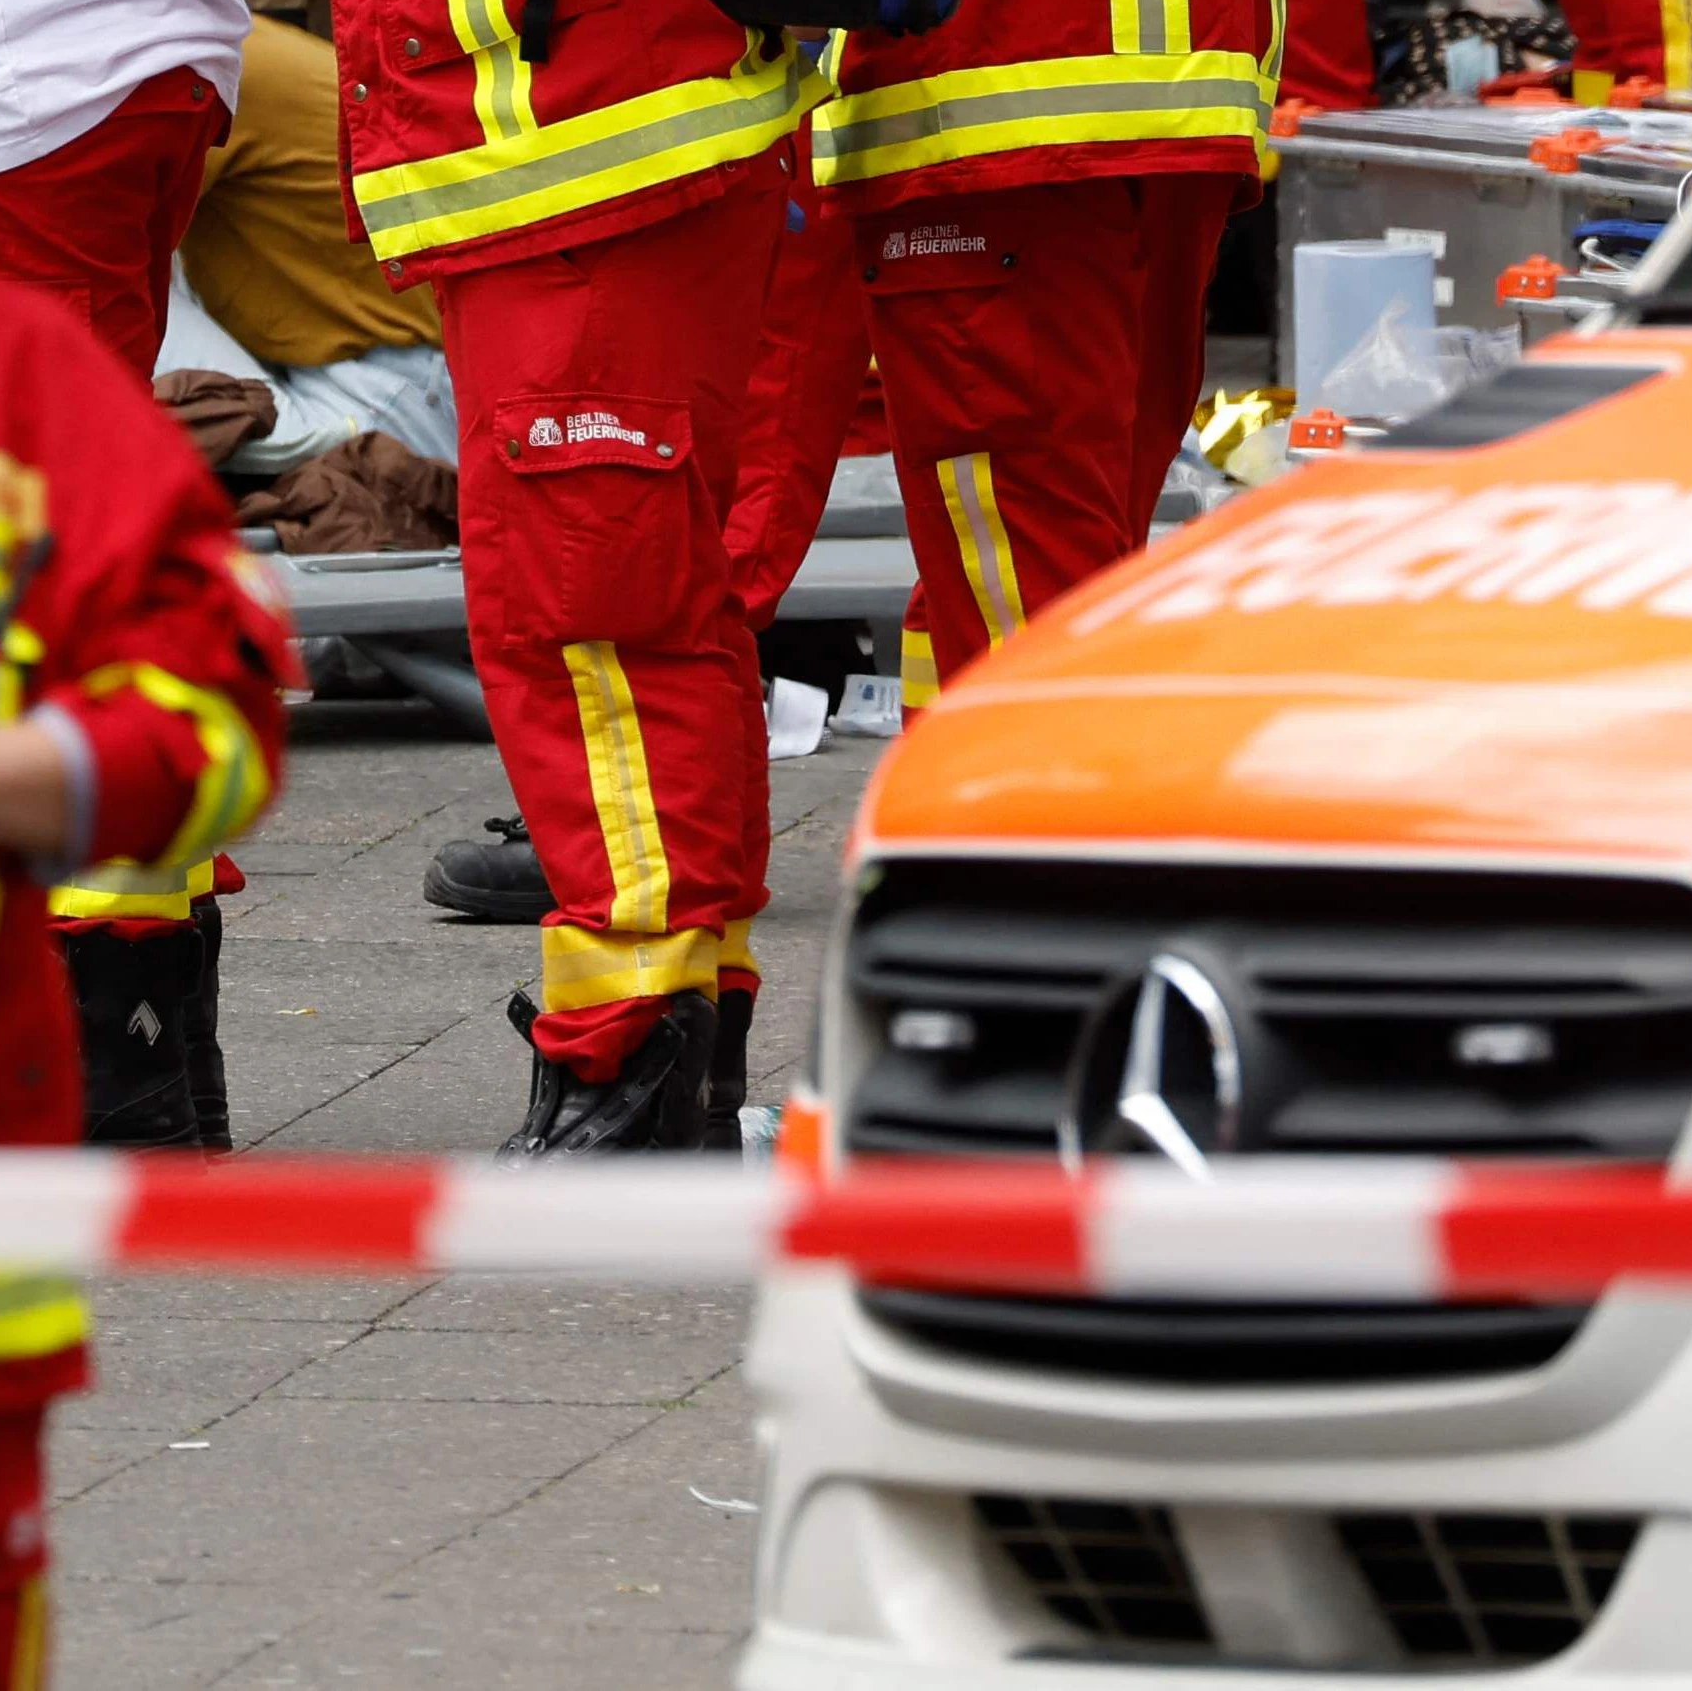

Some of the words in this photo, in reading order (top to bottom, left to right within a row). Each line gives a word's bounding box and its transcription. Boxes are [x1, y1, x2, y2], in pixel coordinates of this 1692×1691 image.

[910, 224, 961, 240] BERLINER
[909, 236, 987, 256] FEUERWEHR
[566, 411, 621, 429] BERLINER
[567, 424, 647, 447] FEUERWEHR
